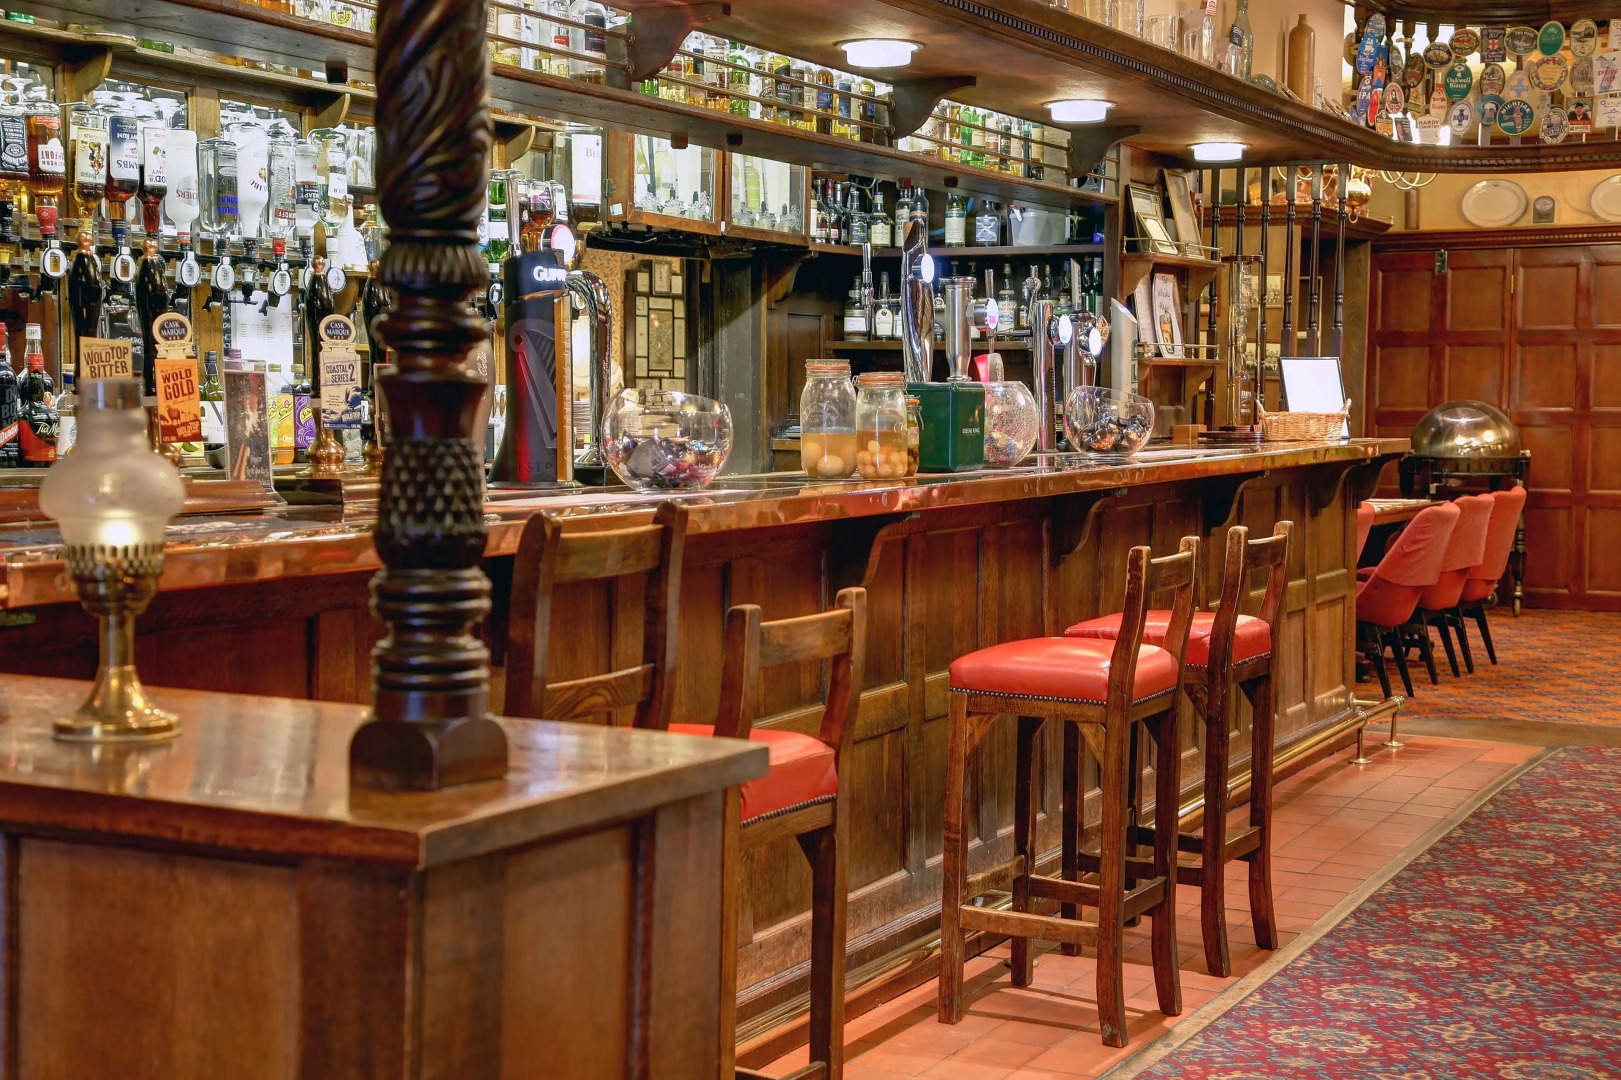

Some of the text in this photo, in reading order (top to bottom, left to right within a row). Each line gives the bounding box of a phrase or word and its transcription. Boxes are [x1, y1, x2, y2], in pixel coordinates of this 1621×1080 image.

[1358, 91, 1371, 100] IPA
[1501, 101, 1531, 114] NIGHTJAR
[116, 159, 139, 170] AMB'S
[330, 321, 345, 329] CASK
[160, 327, 186, 336] MARQUE
[326, 328, 350, 336] MARQUE
[89, 360, 129, 379] BITTER
[325, 364, 348, 374] COASTAL
[348, 363, 356, 382] 2
[161, 368, 192, 384] WOLD
[331, 373, 349, 384] SERIES
[164, 379, 195, 401] GOLD
